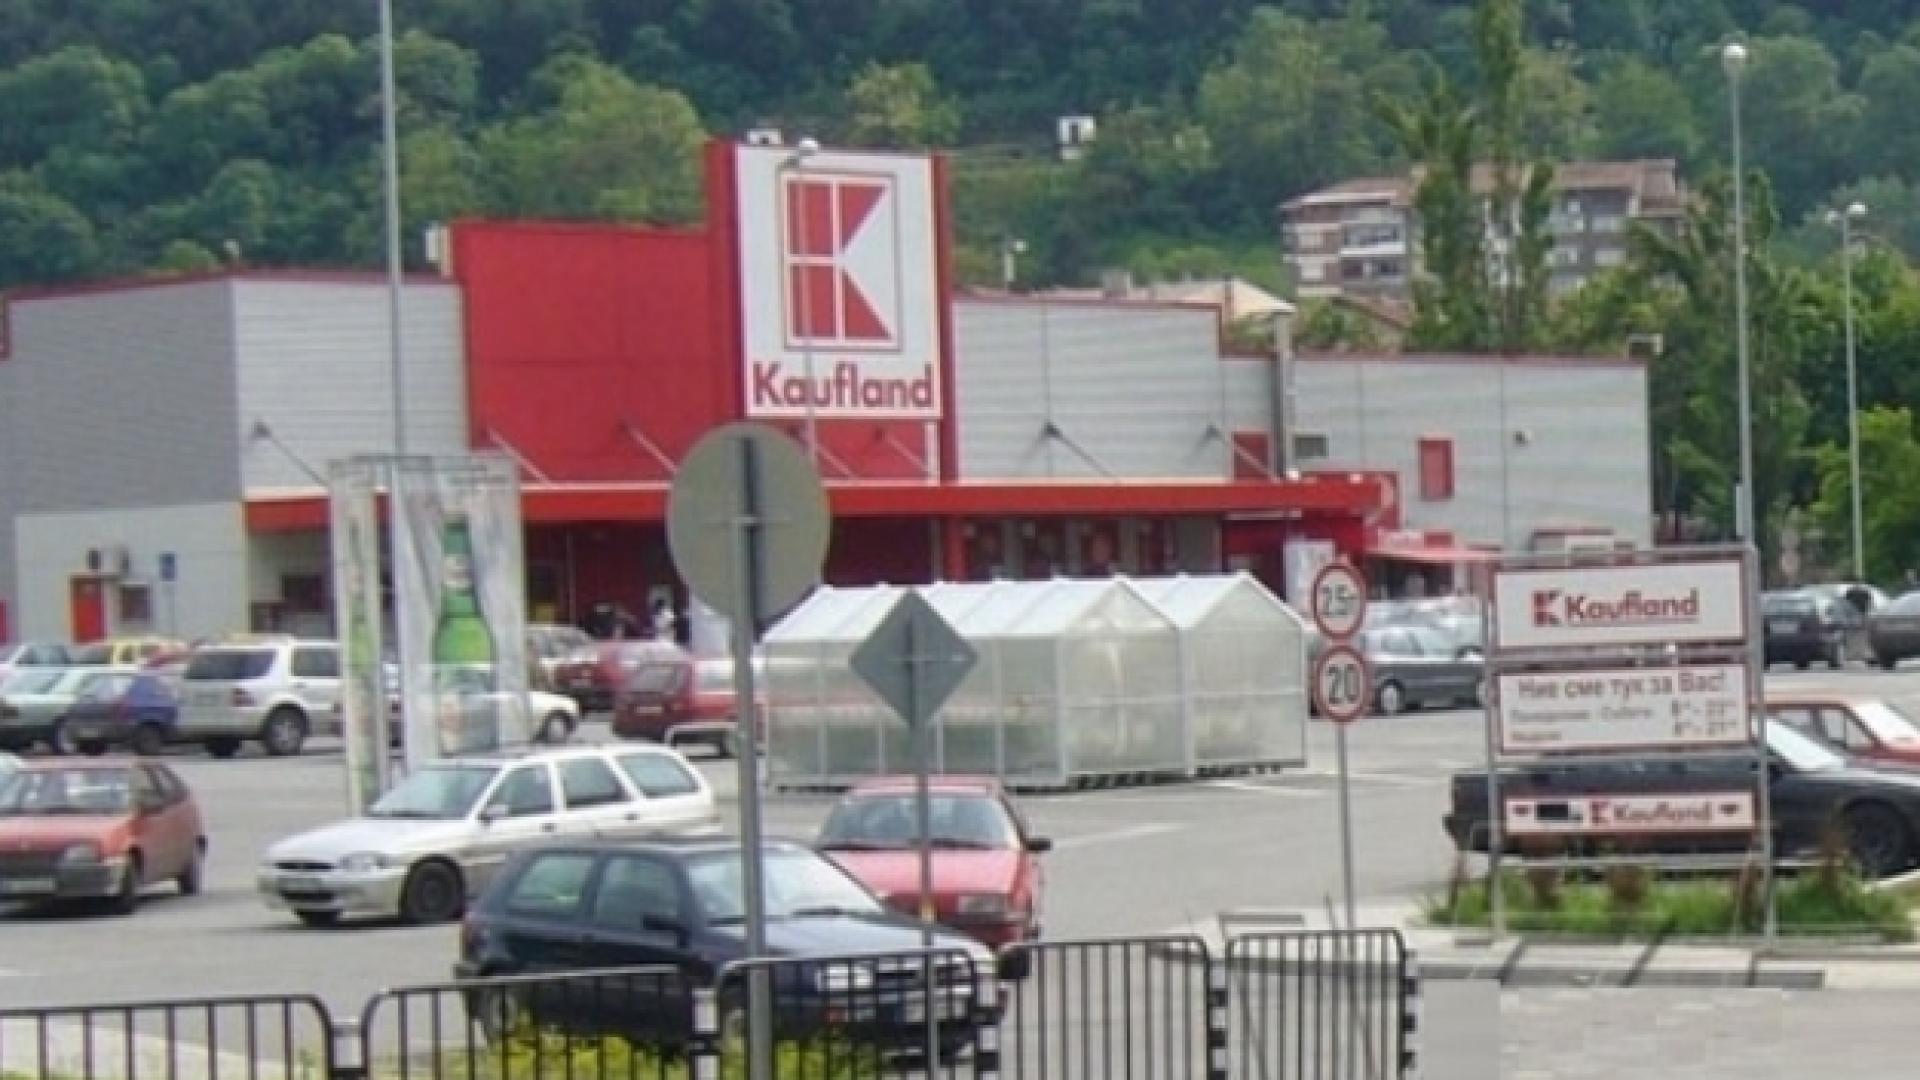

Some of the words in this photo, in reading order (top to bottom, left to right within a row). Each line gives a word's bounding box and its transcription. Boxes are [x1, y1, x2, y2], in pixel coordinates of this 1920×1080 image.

[752, 361, 935, 408] Kaufland
[1566, 587, 1698, 622] Kaufland
[1328, 663, 1361, 704] 20
[1613, 800, 1712, 824] Kaufland
